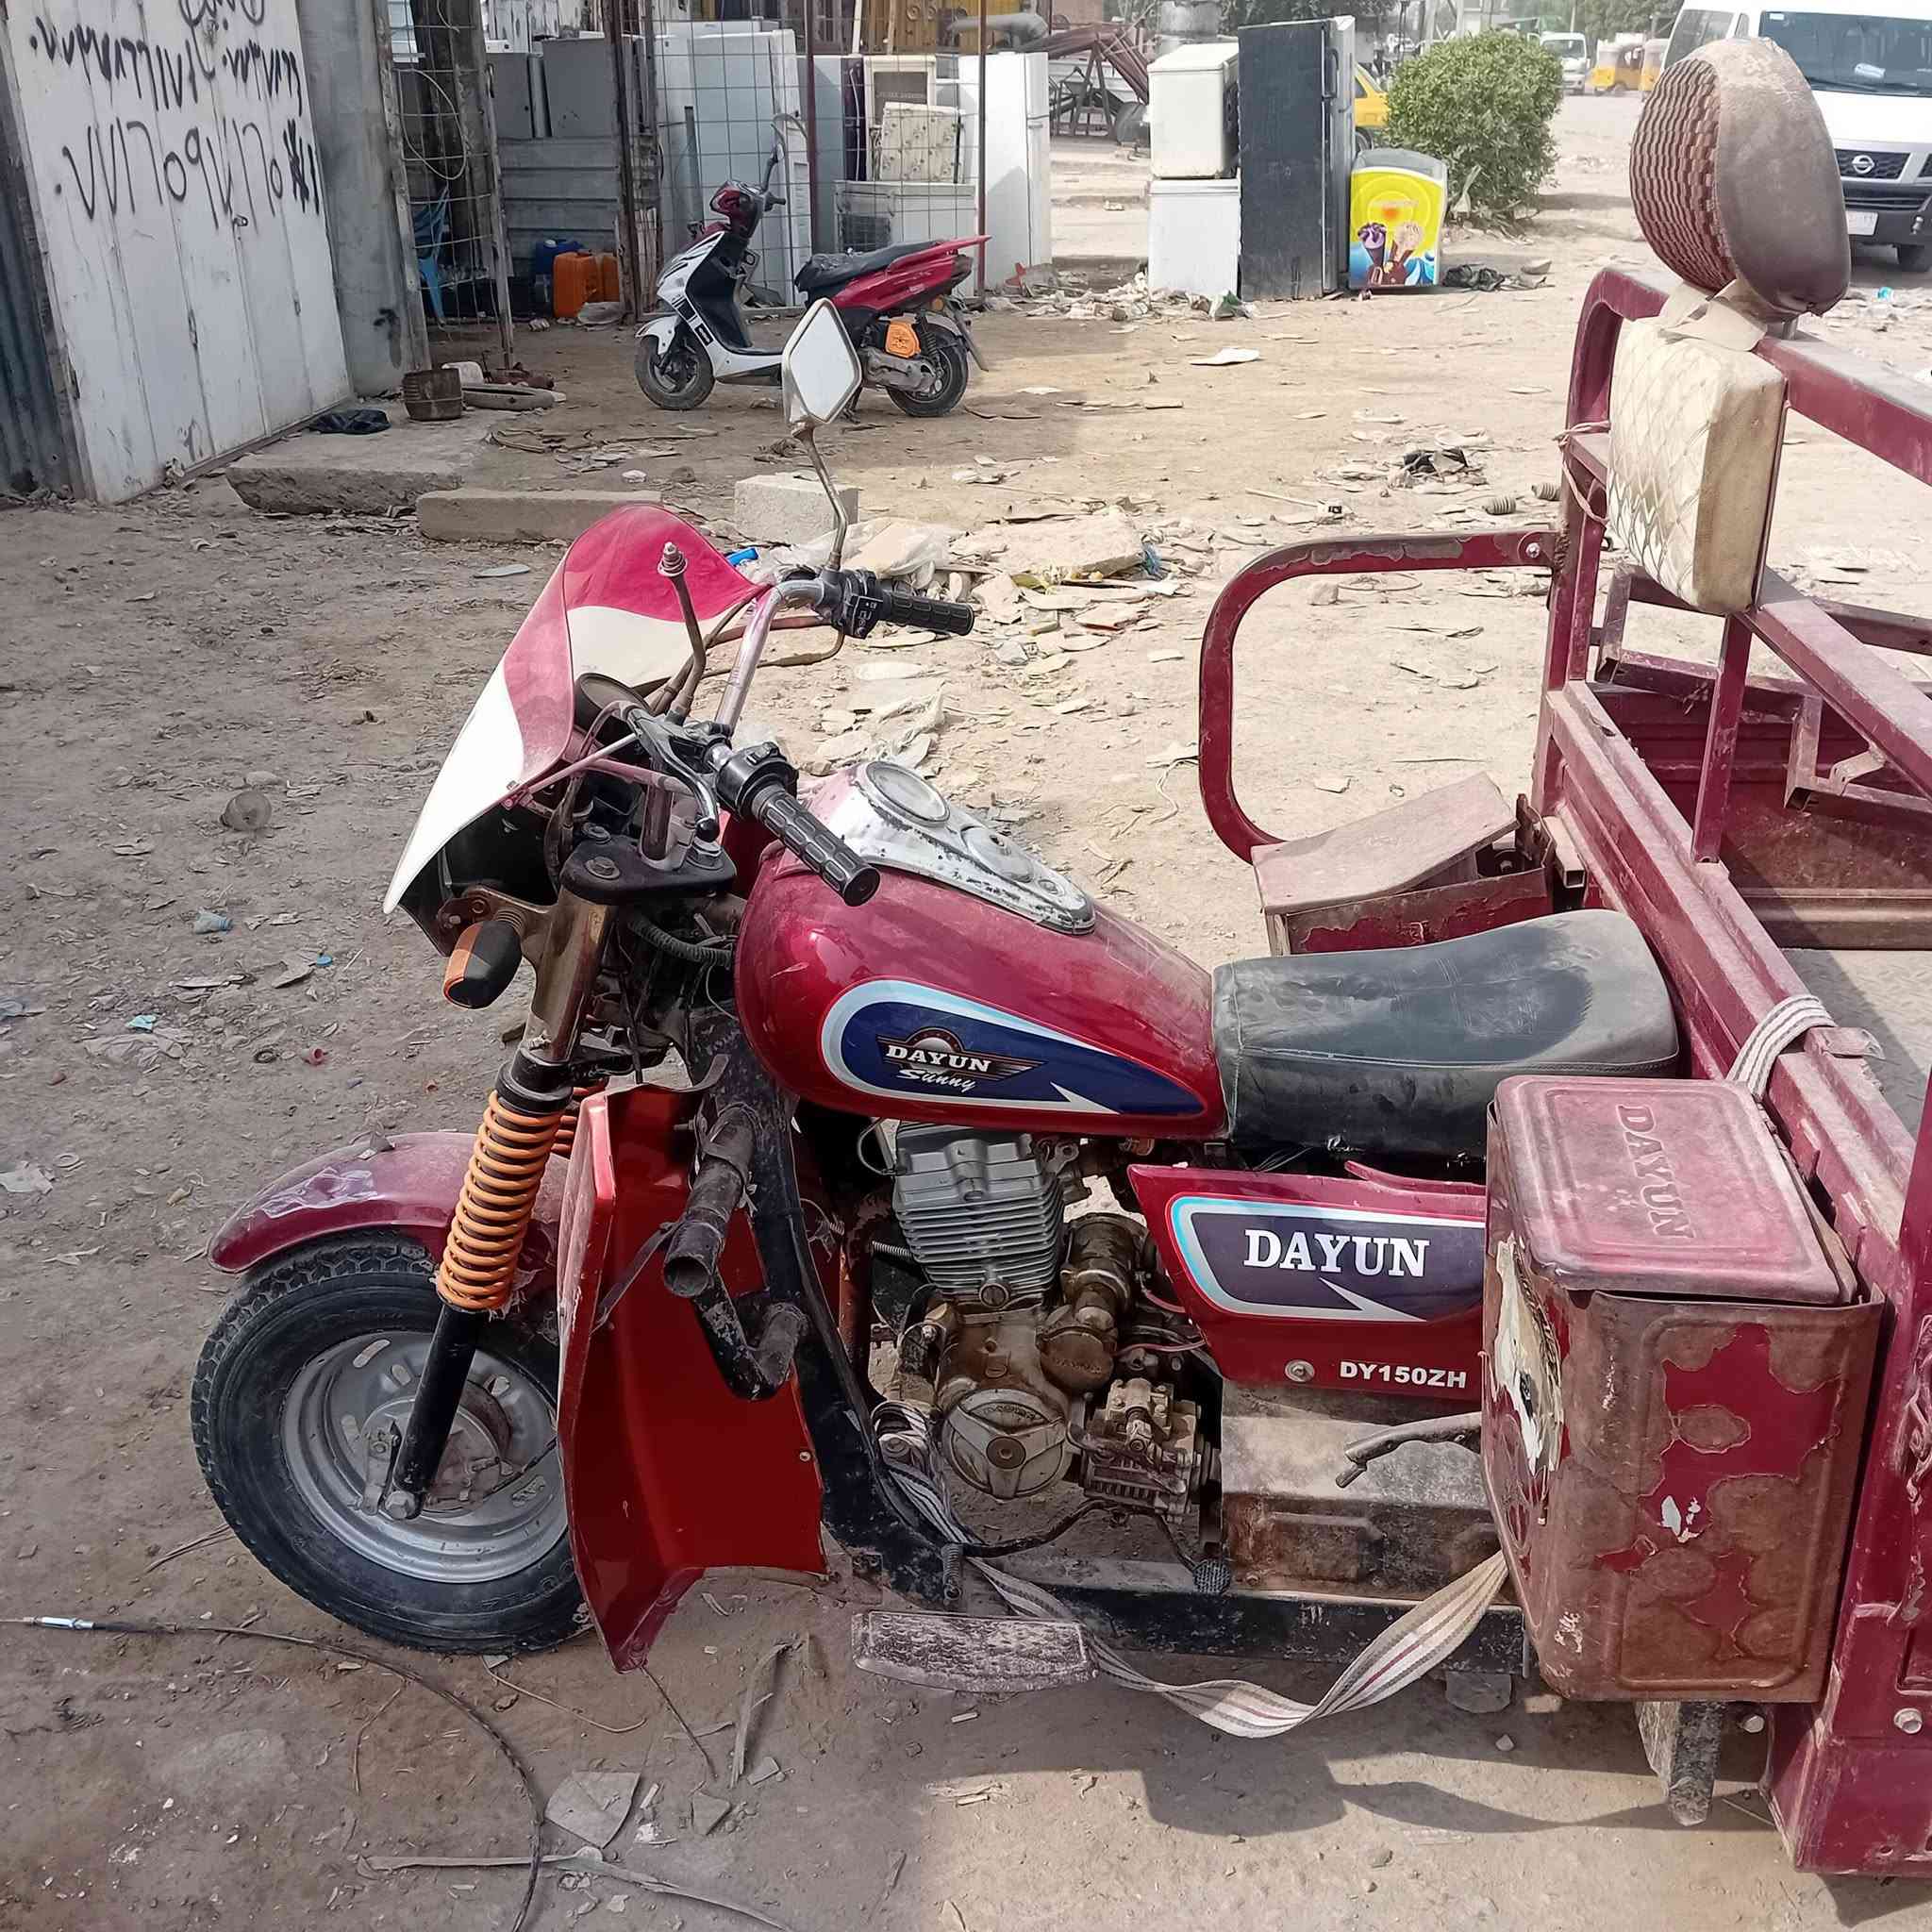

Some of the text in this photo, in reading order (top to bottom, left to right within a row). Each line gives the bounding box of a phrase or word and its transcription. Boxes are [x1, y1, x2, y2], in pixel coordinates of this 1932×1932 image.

[886, 1044, 991, 1073] DAYUN
[896, 1069, 976, 1092] Sunny
[1616, 1104, 1696, 1240] DAYUN
[1243, 1229, 1430, 1277] DAYUN
[1340, 1361, 1468, 1389] DY150ZH
